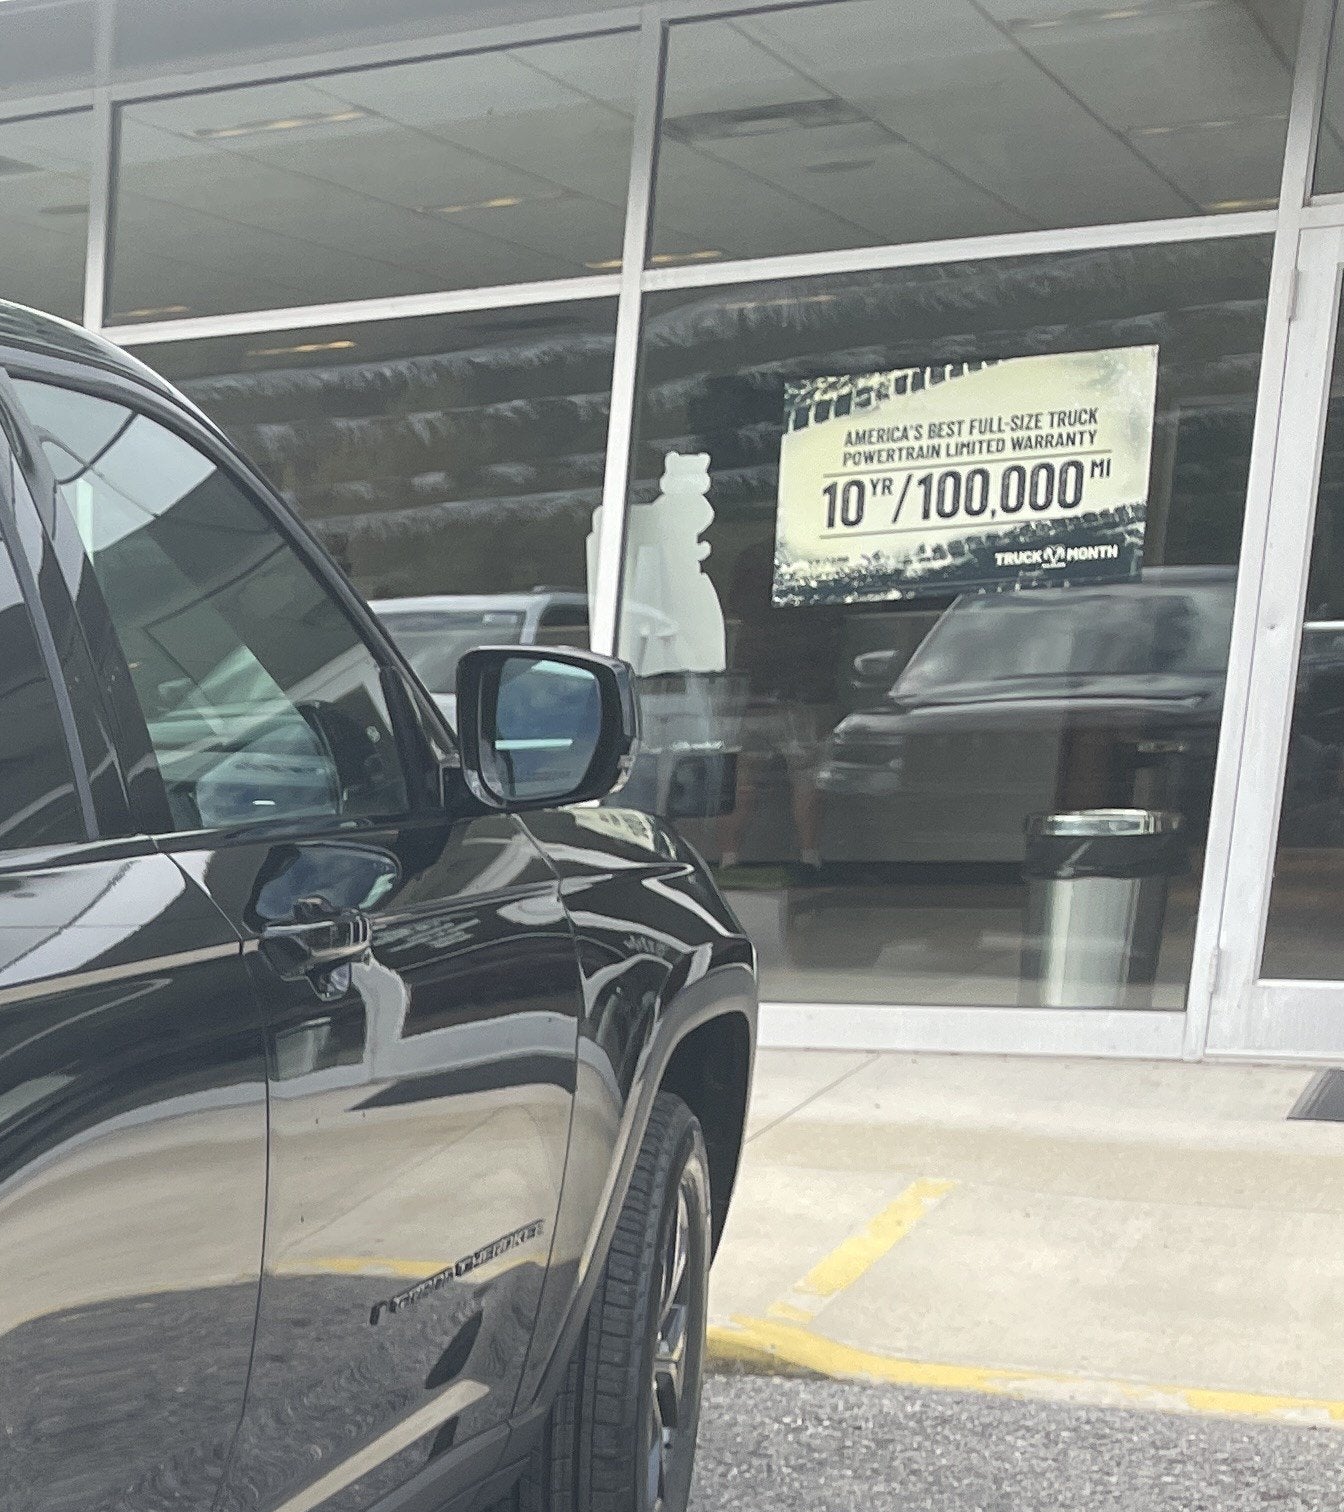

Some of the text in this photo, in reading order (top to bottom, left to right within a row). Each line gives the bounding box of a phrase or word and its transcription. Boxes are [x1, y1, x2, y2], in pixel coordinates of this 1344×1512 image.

[844, 406, 1099, 448] AMERICA'S BEST FULL-SIZE TRUCK
[842, 429, 1098, 467] POWERTRAIN LIMITED WARRANTY
[994, 550, 1042, 567] TRUCK
[1066, 544, 1119, 561] MONTH
